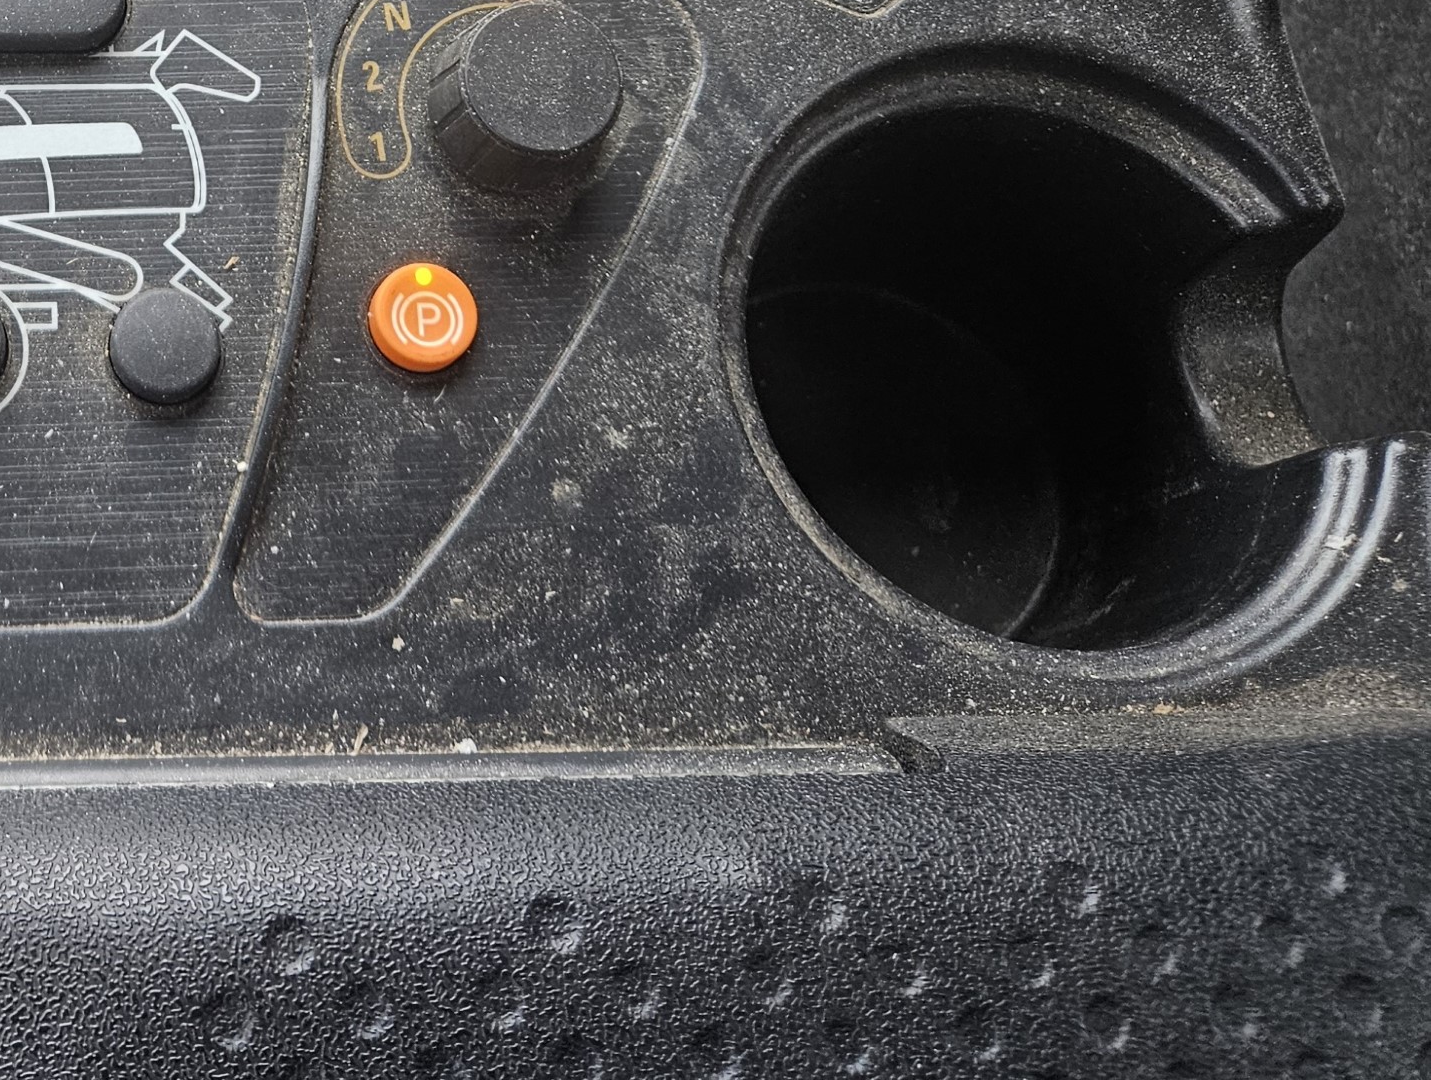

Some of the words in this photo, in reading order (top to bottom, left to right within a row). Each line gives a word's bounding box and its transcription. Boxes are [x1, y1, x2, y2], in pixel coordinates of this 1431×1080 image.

[383, 0, 412, 32] N
[362, 60, 385, 93] 2
[369, 130, 387, 162] 1
[416, 301, 442, 338] P
